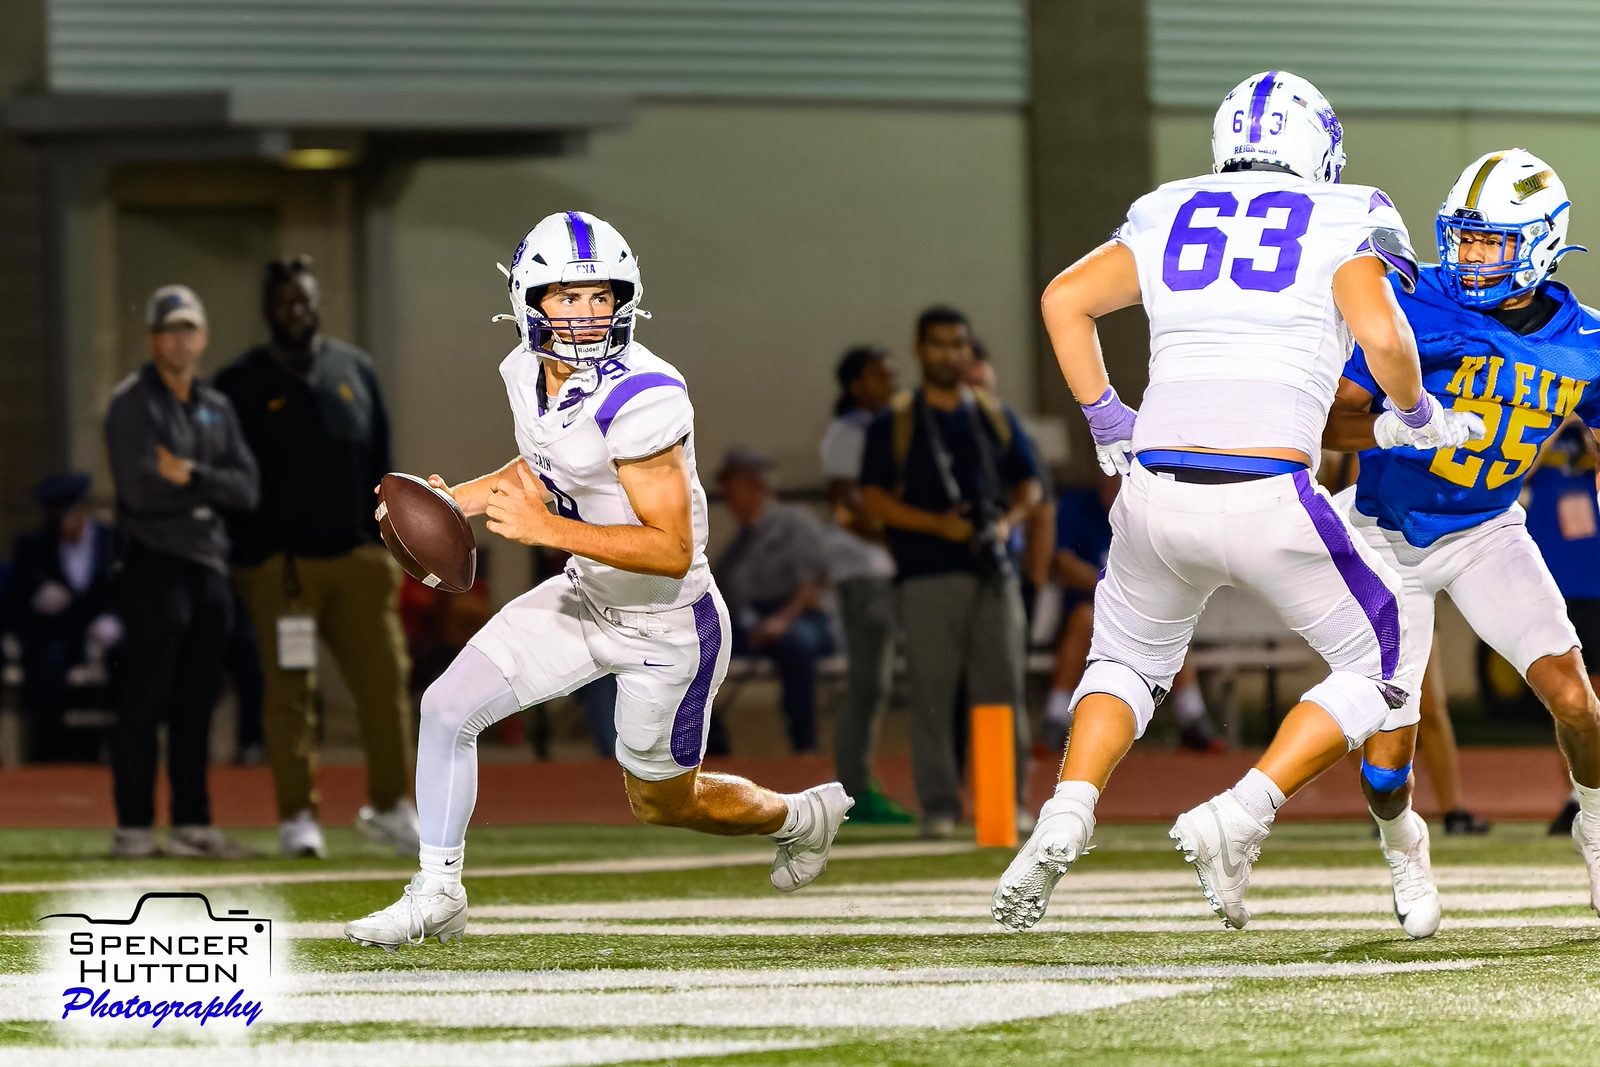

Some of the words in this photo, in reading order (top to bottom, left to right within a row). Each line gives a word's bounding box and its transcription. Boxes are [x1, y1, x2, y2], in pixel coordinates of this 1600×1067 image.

[1162, 190, 1316, 293] 63
[578, 346, 600, 354] Riddell
[1445, 355, 1591, 418] KLEIN
[1429, 397, 1553, 490] 25
